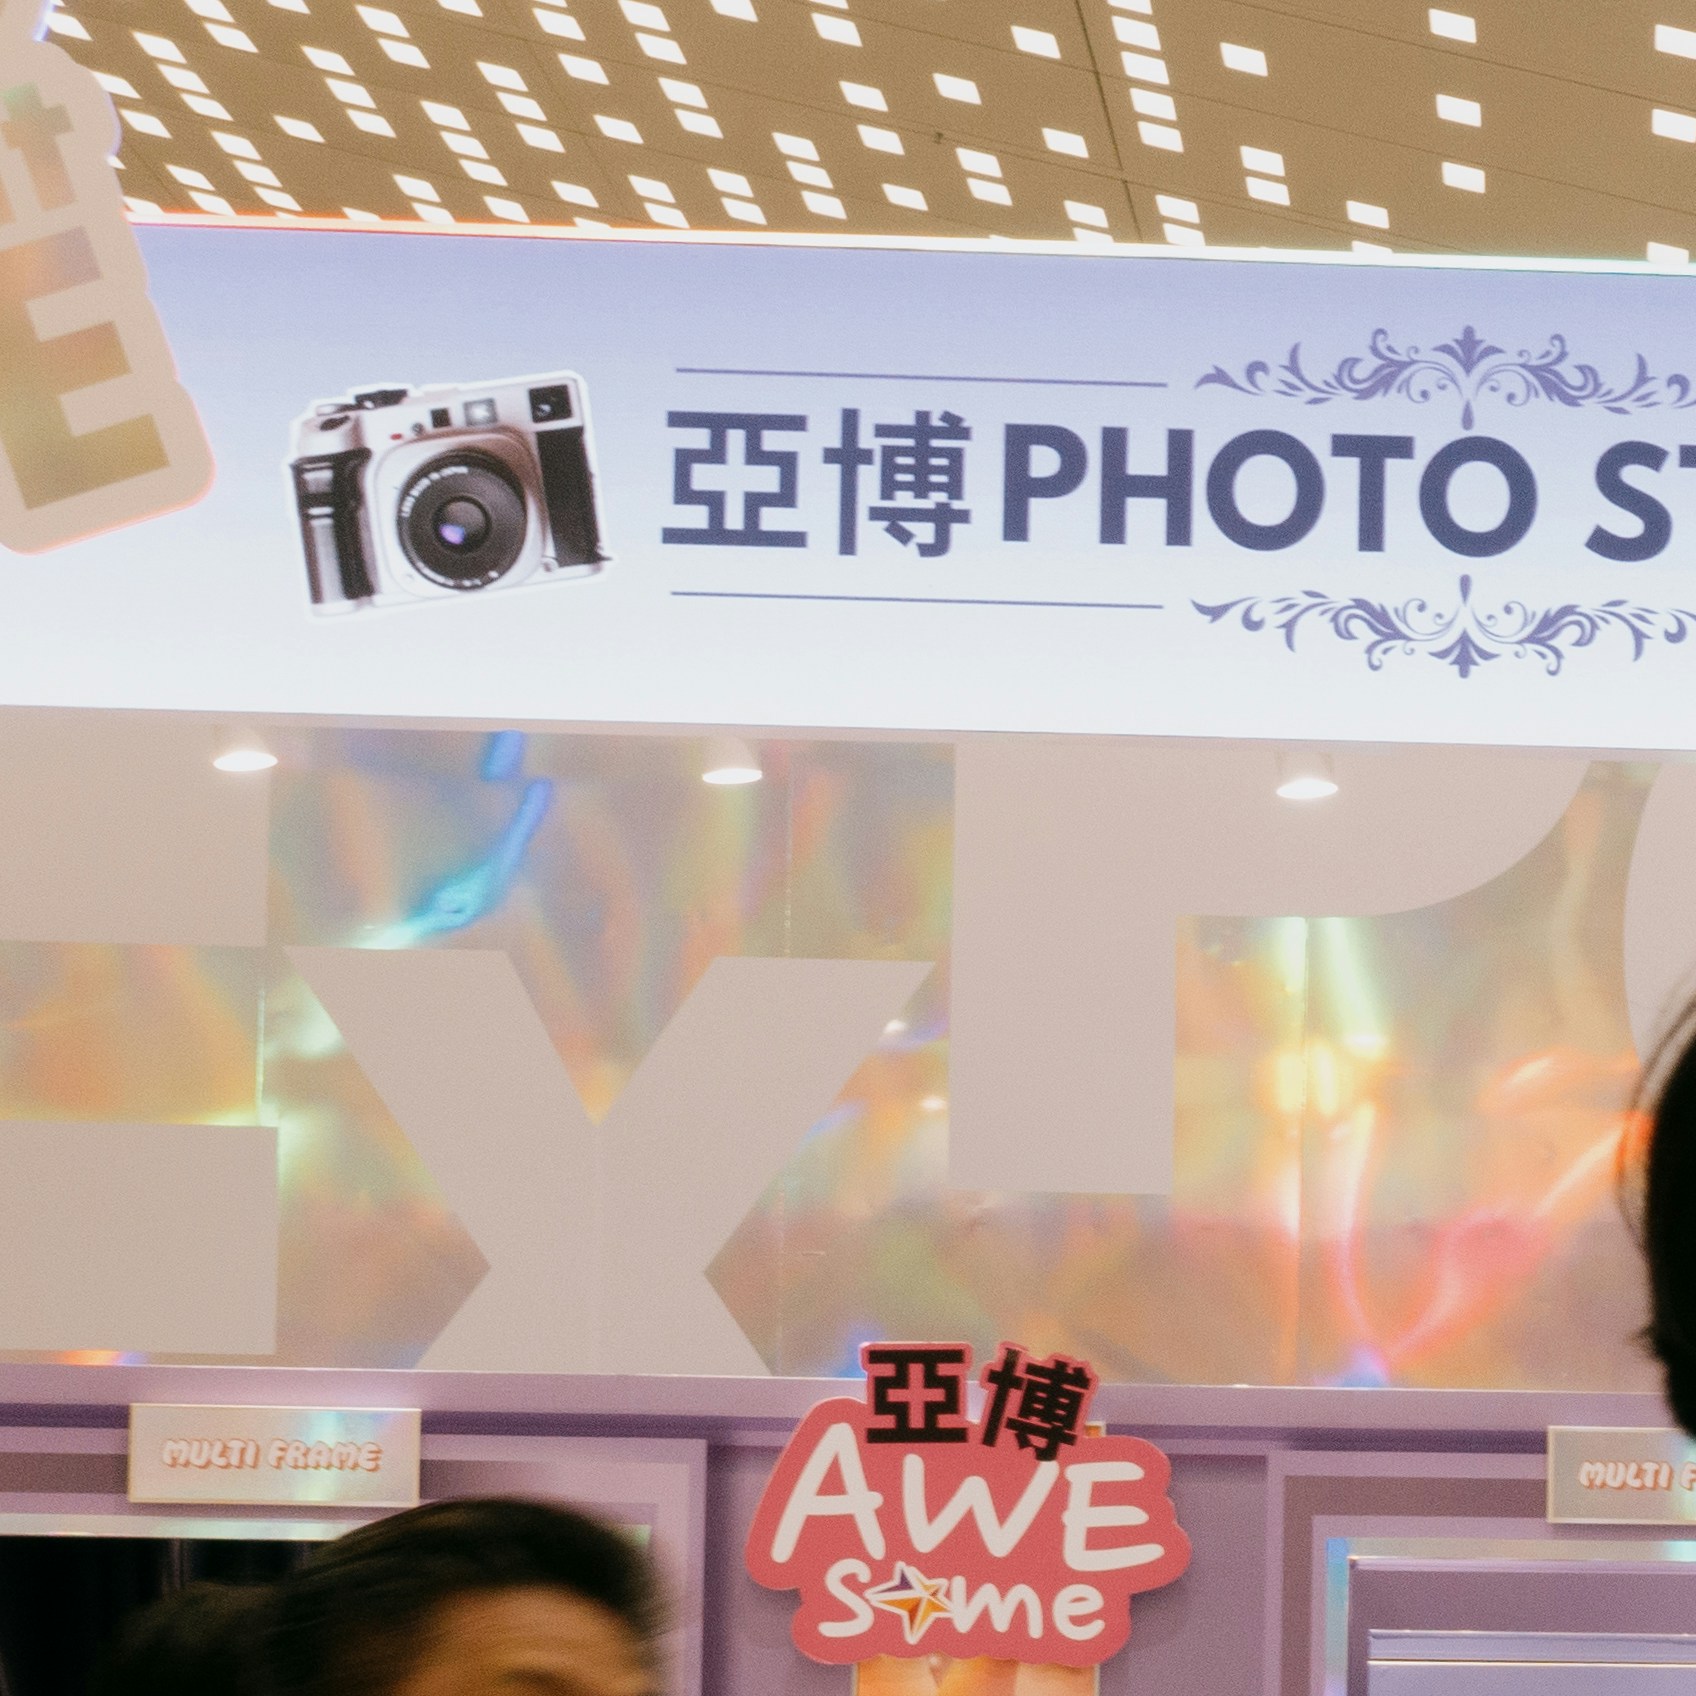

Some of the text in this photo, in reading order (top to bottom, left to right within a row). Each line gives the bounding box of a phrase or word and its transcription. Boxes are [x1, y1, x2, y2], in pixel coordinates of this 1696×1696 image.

[661, 408, 973, 558] 亞博
[1002, 423, 1538, 558] PHOTO
[162, 1438, 383, 1473] MULTI FRAME
[867, 1347, 1092, 1462] 亞博
[770, 1422, 1165, 1572] AWE
[1578, 1460, 1673, 1491] MULTI
